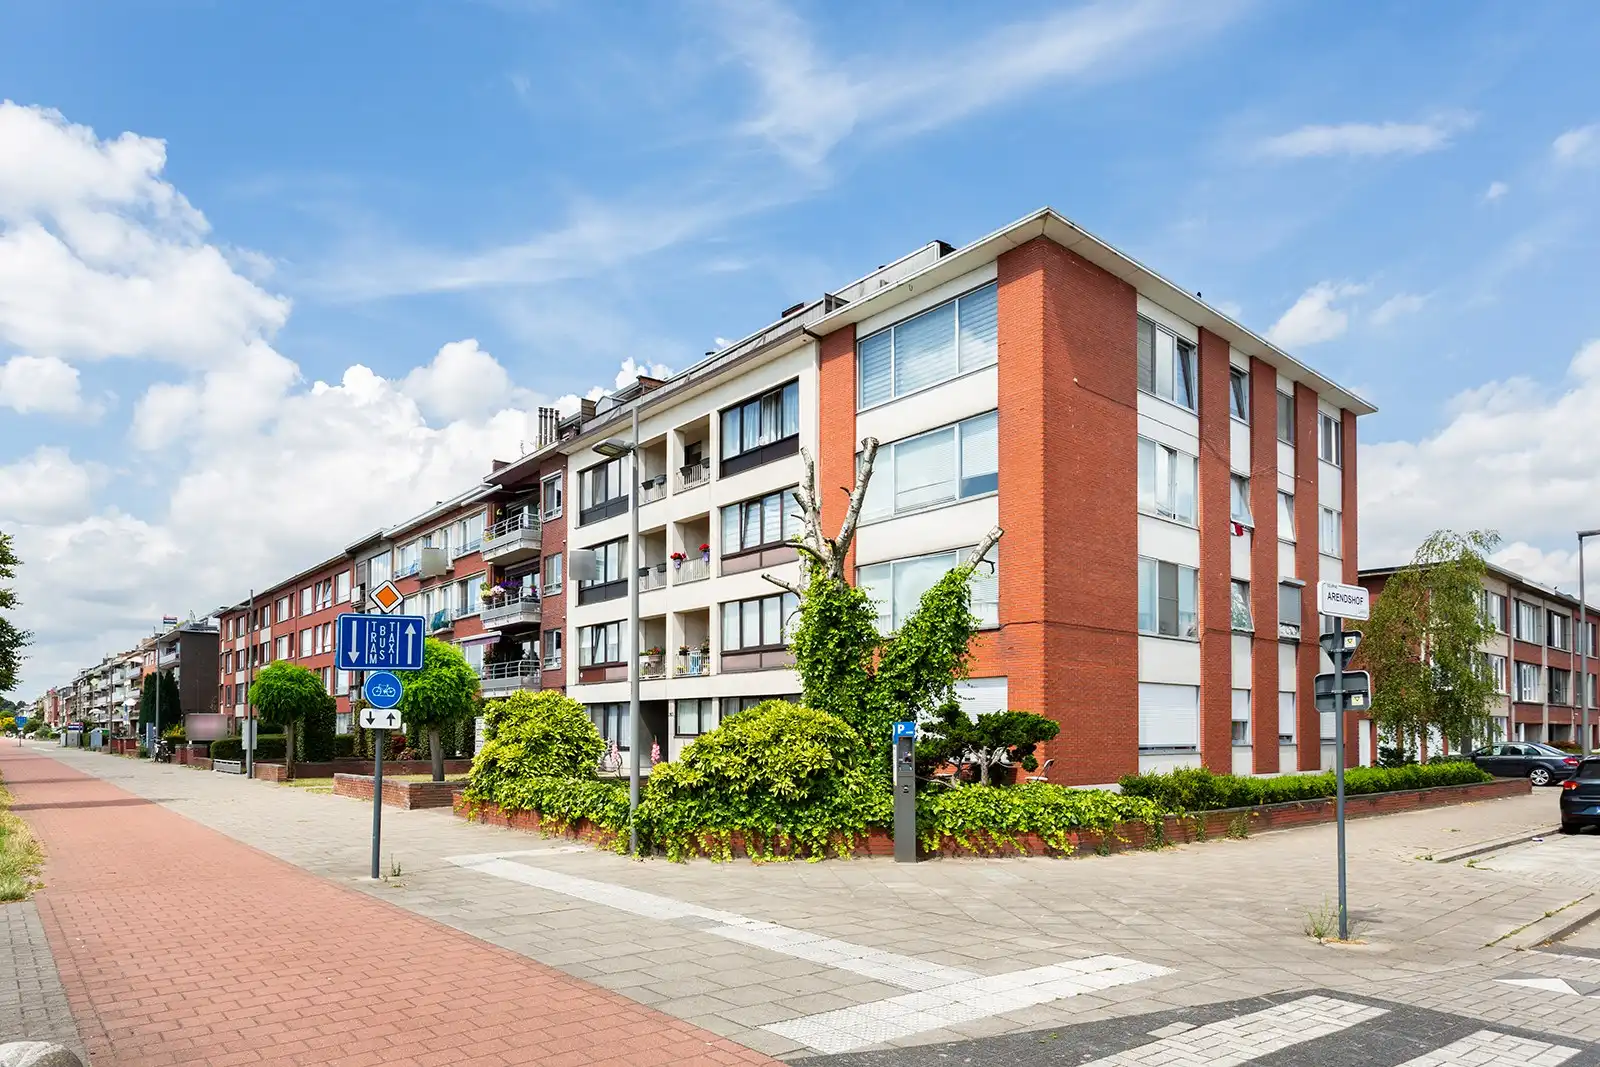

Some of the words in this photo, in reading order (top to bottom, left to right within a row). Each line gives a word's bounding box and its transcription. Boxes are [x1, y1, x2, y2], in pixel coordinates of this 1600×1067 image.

[1327, 592, 1364, 605] ARENDSHOF
[369, 621, 378, 665] TRAM
[388, 621, 396, 665] TAXI
[897, 724, 905, 735] P
